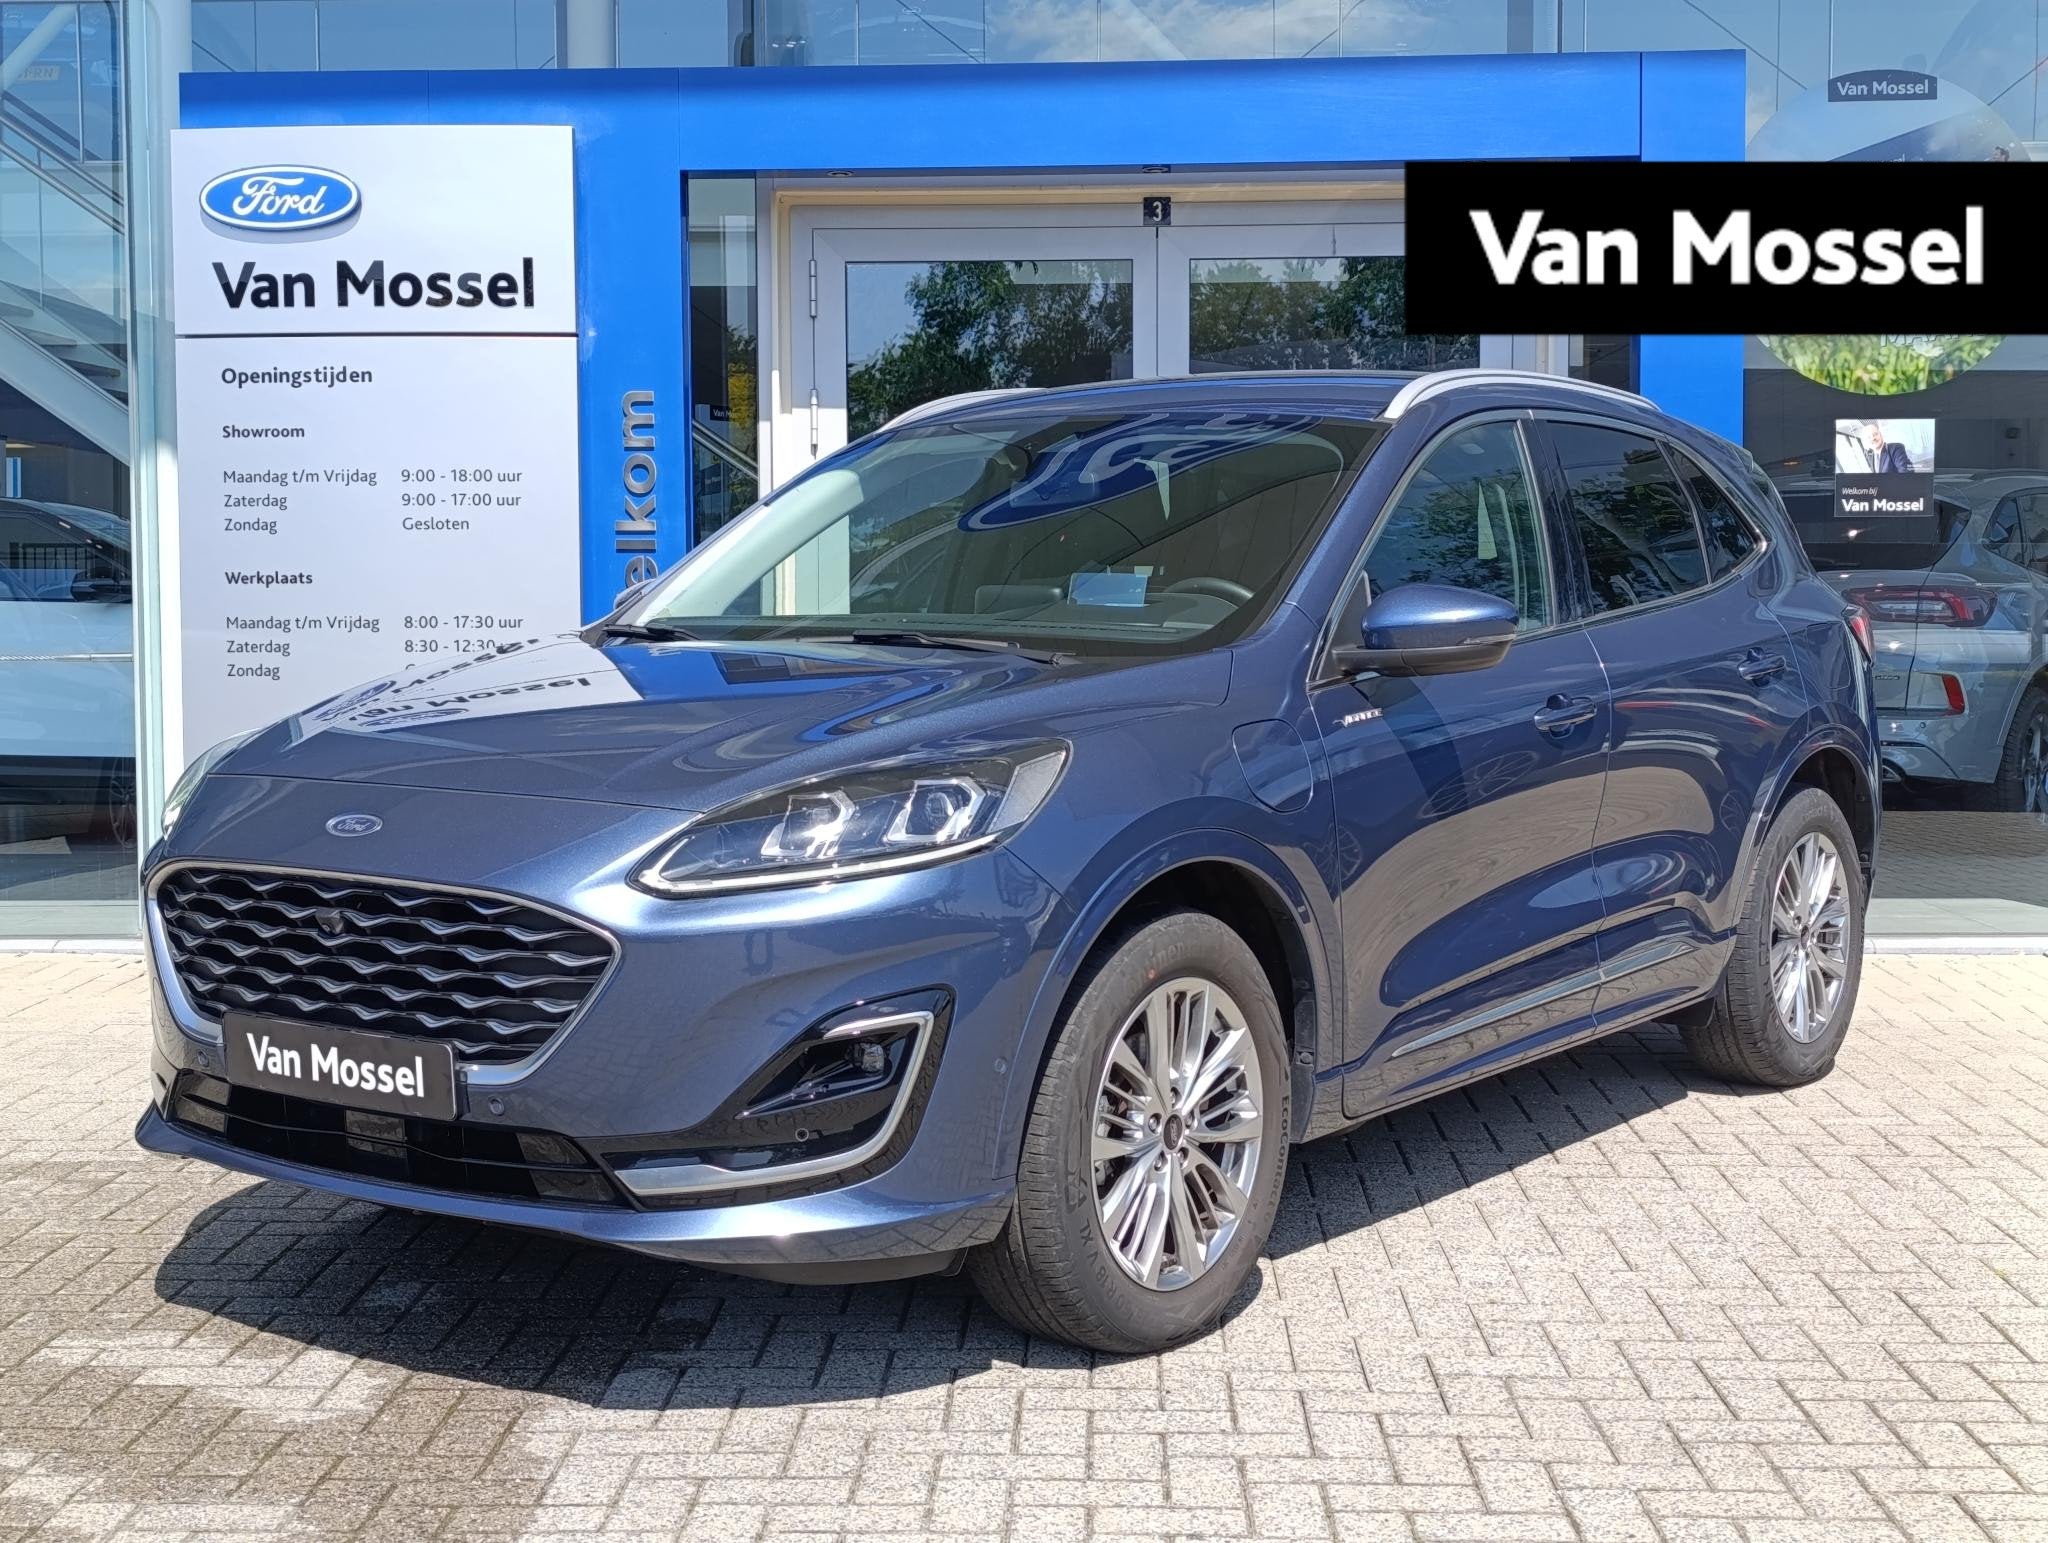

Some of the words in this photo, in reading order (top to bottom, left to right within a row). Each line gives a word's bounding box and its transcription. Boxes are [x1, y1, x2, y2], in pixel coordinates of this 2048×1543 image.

[1837, 82, 1868, 96] Van
[1872, 79, 1929, 95] Mossel
[232, 176, 328, 215] Ford
[1153, 201, 1161, 221] 3
[212, 261, 315, 309] Van
[336, 257, 535, 308] Mossel
[221, 366, 373, 389] Openingstijden
[222, 425, 305, 439] Showroom
[223, 470, 288, 486] Maandag
[292, 469, 319, 483] t/m
[323, 468, 377, 486] Vrijdag
[401, 469, 436, 482] 9:00
[450, 469, 493, 482] 18:00
[497, 472, 522, 482] uur
[615, 391, 658, 589] elkom
[1842, 487, 1868, 496] Welkom
[224, 494, 288, 511] Zaterdag
[401, 493, 436, 506] 9:00
[450, 493, 492, 506] 17:00
[496, 496, 521, 506] uur
[1842, 499, 1869, 512] Van
[1873, 498, 1924, 512] Mossel
[224, 517, 278, 535] Zondag
[402, 517, 470, 531] Gesloten
[225, 571, 313, 588] Werkplaats
[226, 616, 291, 633] Maandag
[295, 616, 322, 630] t/m
[326, 615, 380, 633] Vrijdag
[404, 616, 438, 629] 8:00
[453, 616, 494, 629] 17:30
[498, 618, 524, 629] uur
[227, 640, 291, 658] Zaterdag
[404, 640, 438, 653] 8:30
[227, 664, 281, 681] Zondag
[246, 1033, 302, 1079] Van
[310, 1043, 425, 1098] Mossel
